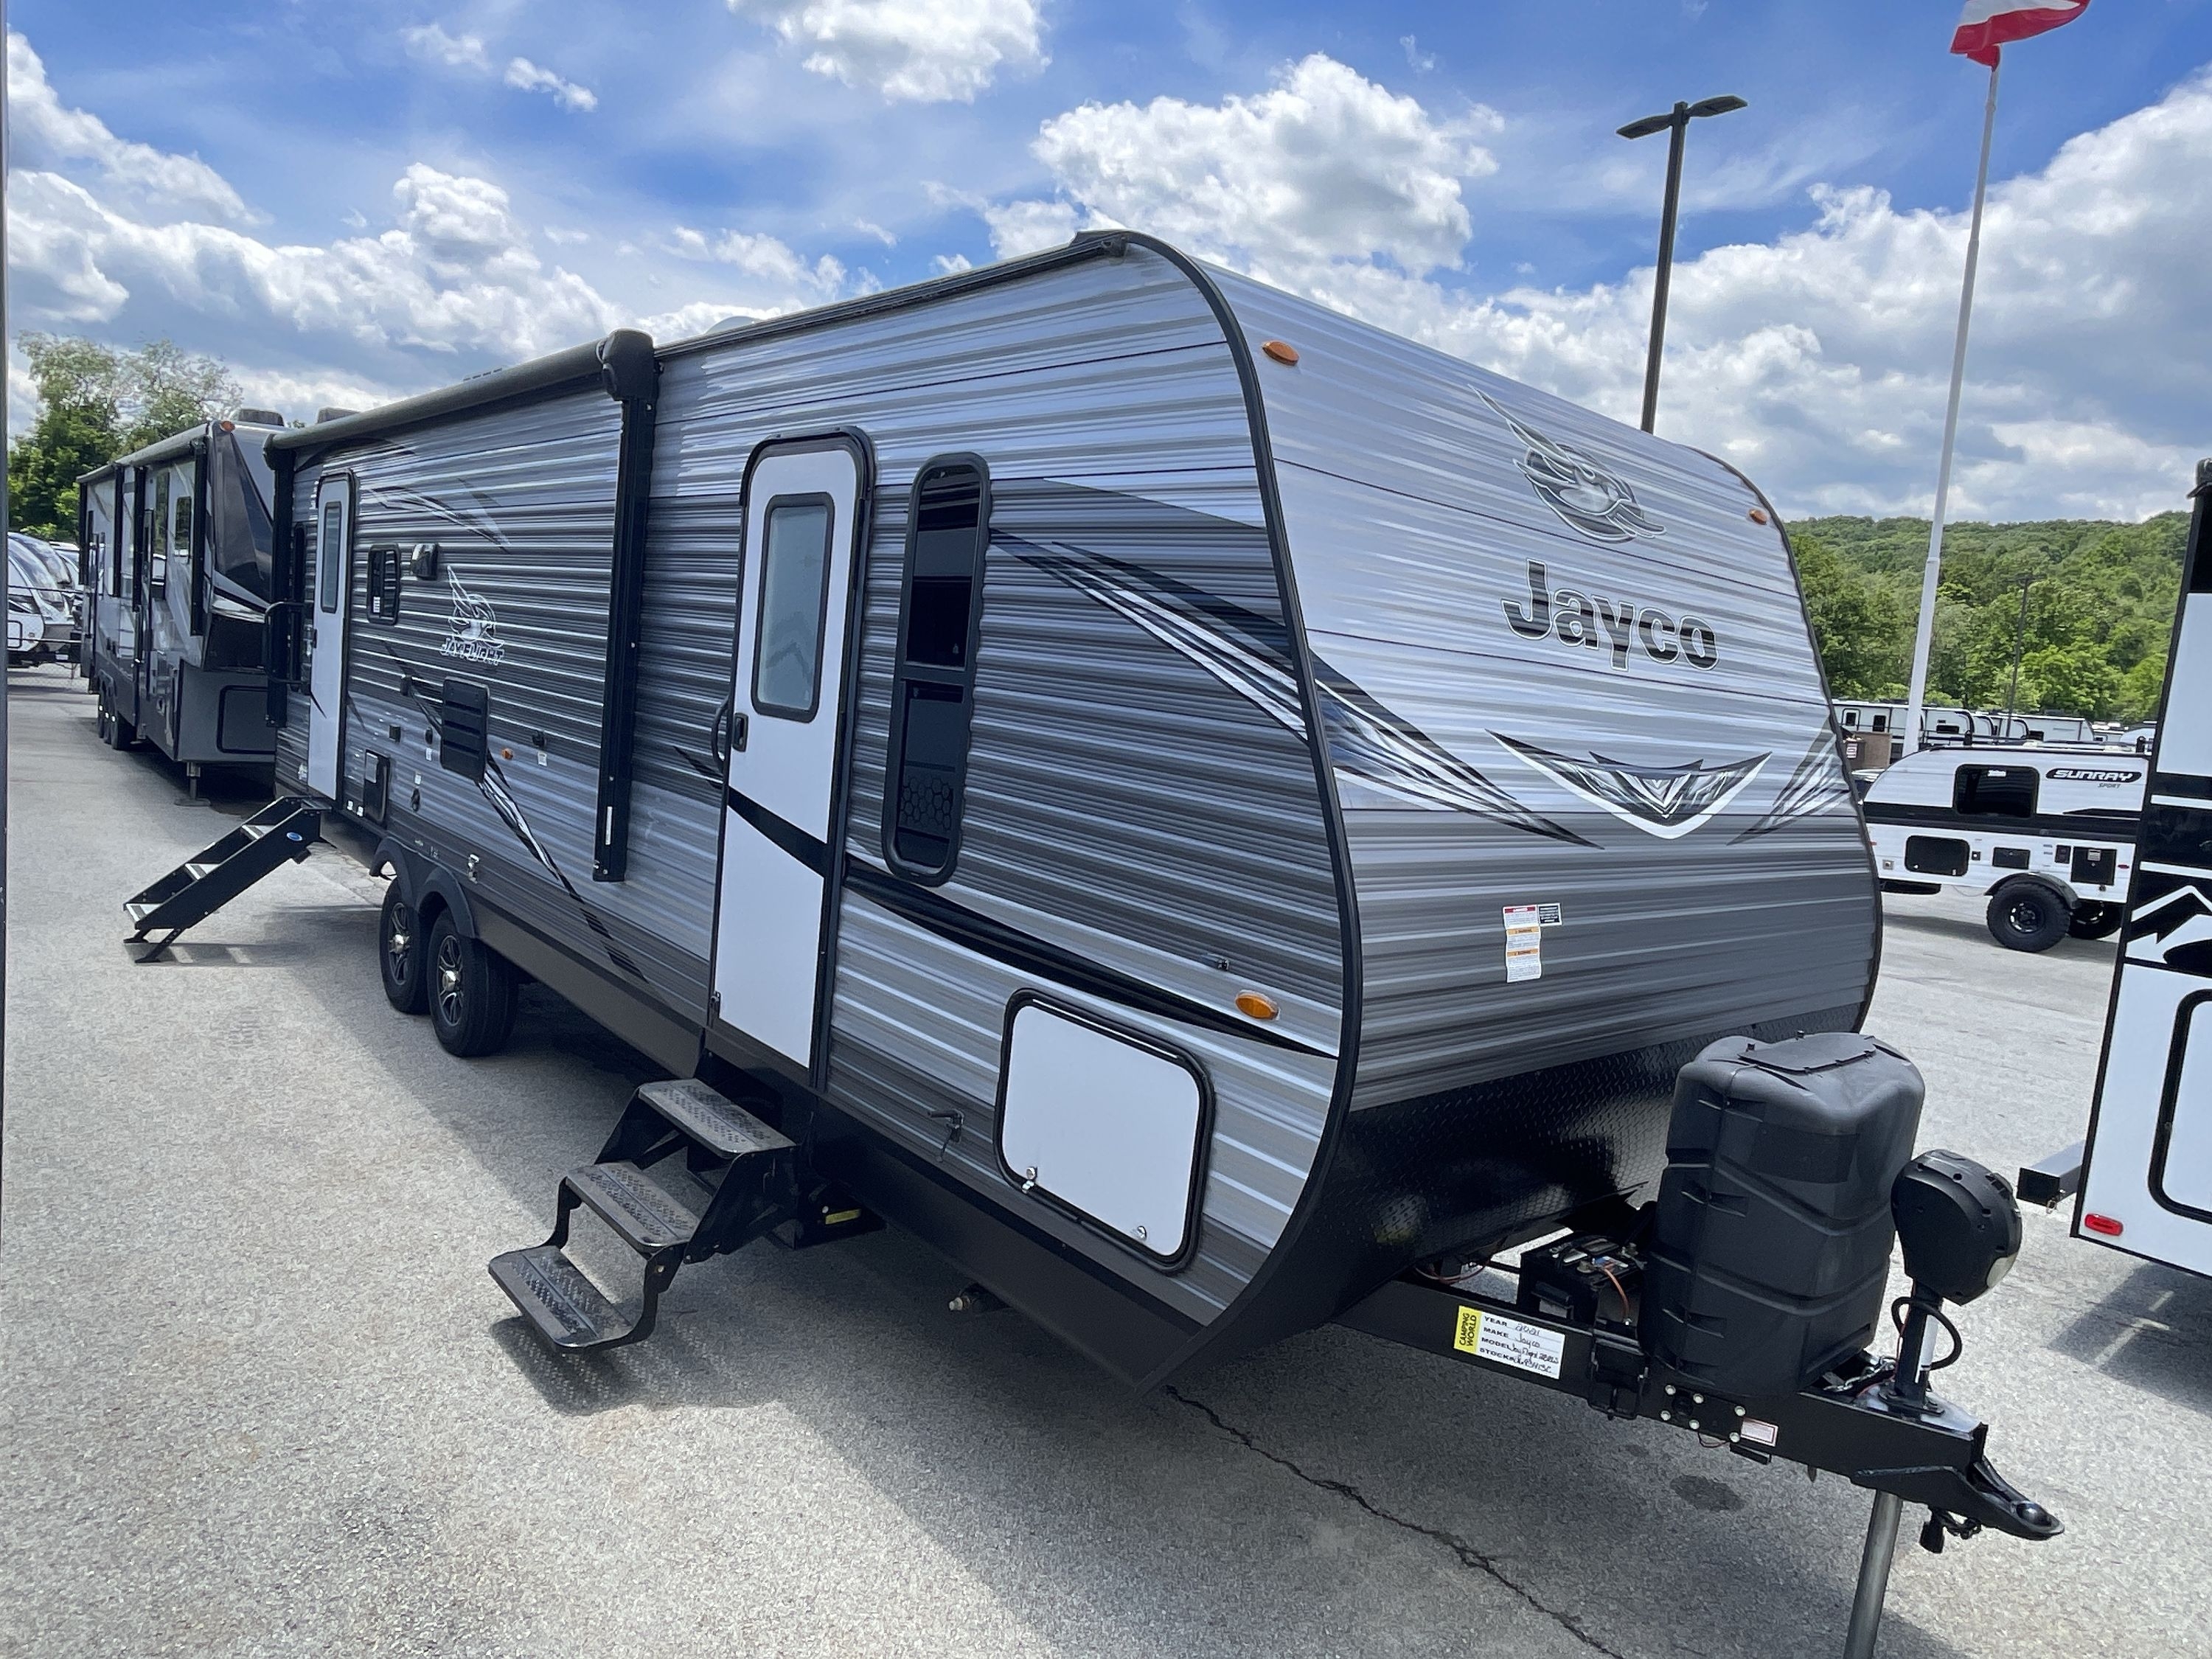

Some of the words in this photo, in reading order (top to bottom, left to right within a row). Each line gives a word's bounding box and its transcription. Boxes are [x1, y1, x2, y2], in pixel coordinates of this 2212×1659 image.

[1500, 557, 1719, 672] Jayco
[2053, 770, 2133, 782] SUNRAY
[1484, 1316, 1508, 1326] YEAR
[1459, 1312, 1470, 1346] CAMPING
[1466, 1315, 1477, 1346] WORLD
[1483, 1327, 1509, 1338] MAKE
[1481, 1338, 1512, 1349] MODEL
